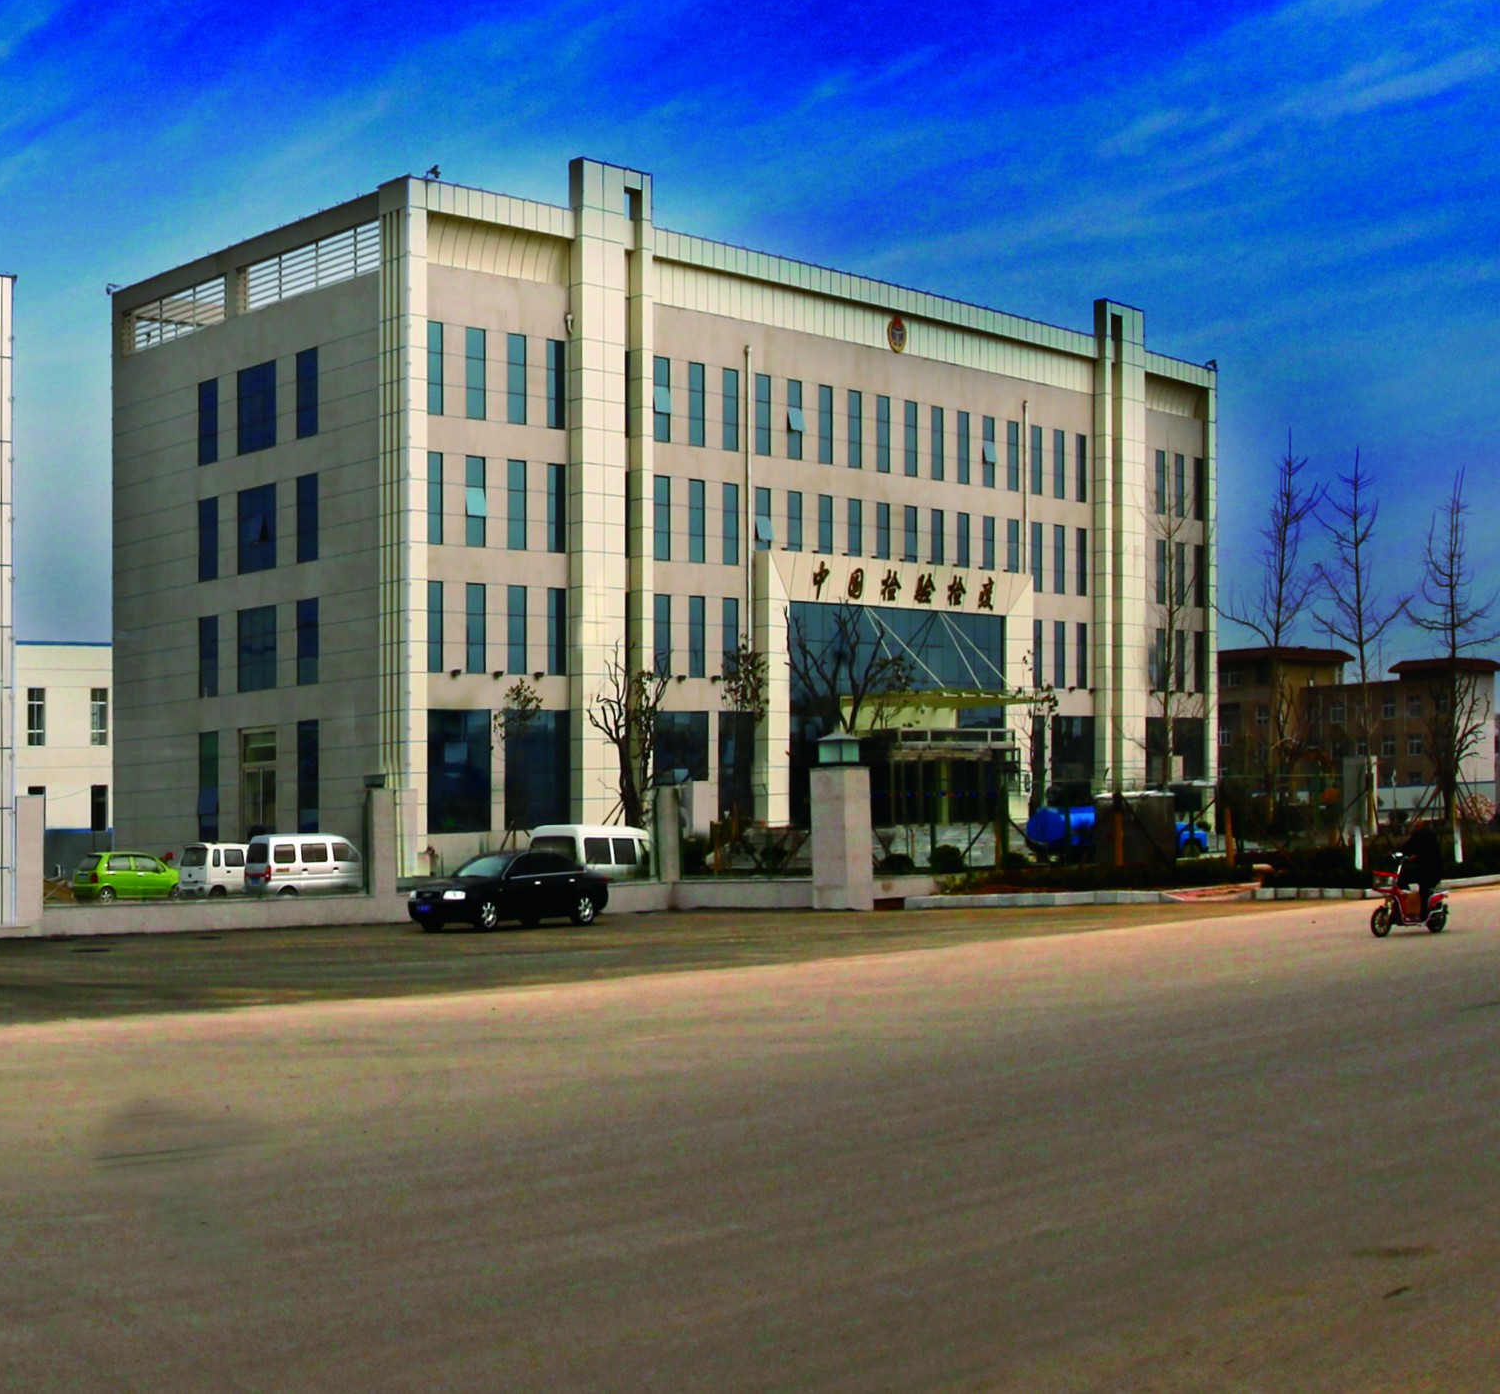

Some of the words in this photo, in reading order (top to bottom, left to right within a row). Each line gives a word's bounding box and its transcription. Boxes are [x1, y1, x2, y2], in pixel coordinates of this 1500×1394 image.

[813, 560, 995, 611] 中国检验检疫
